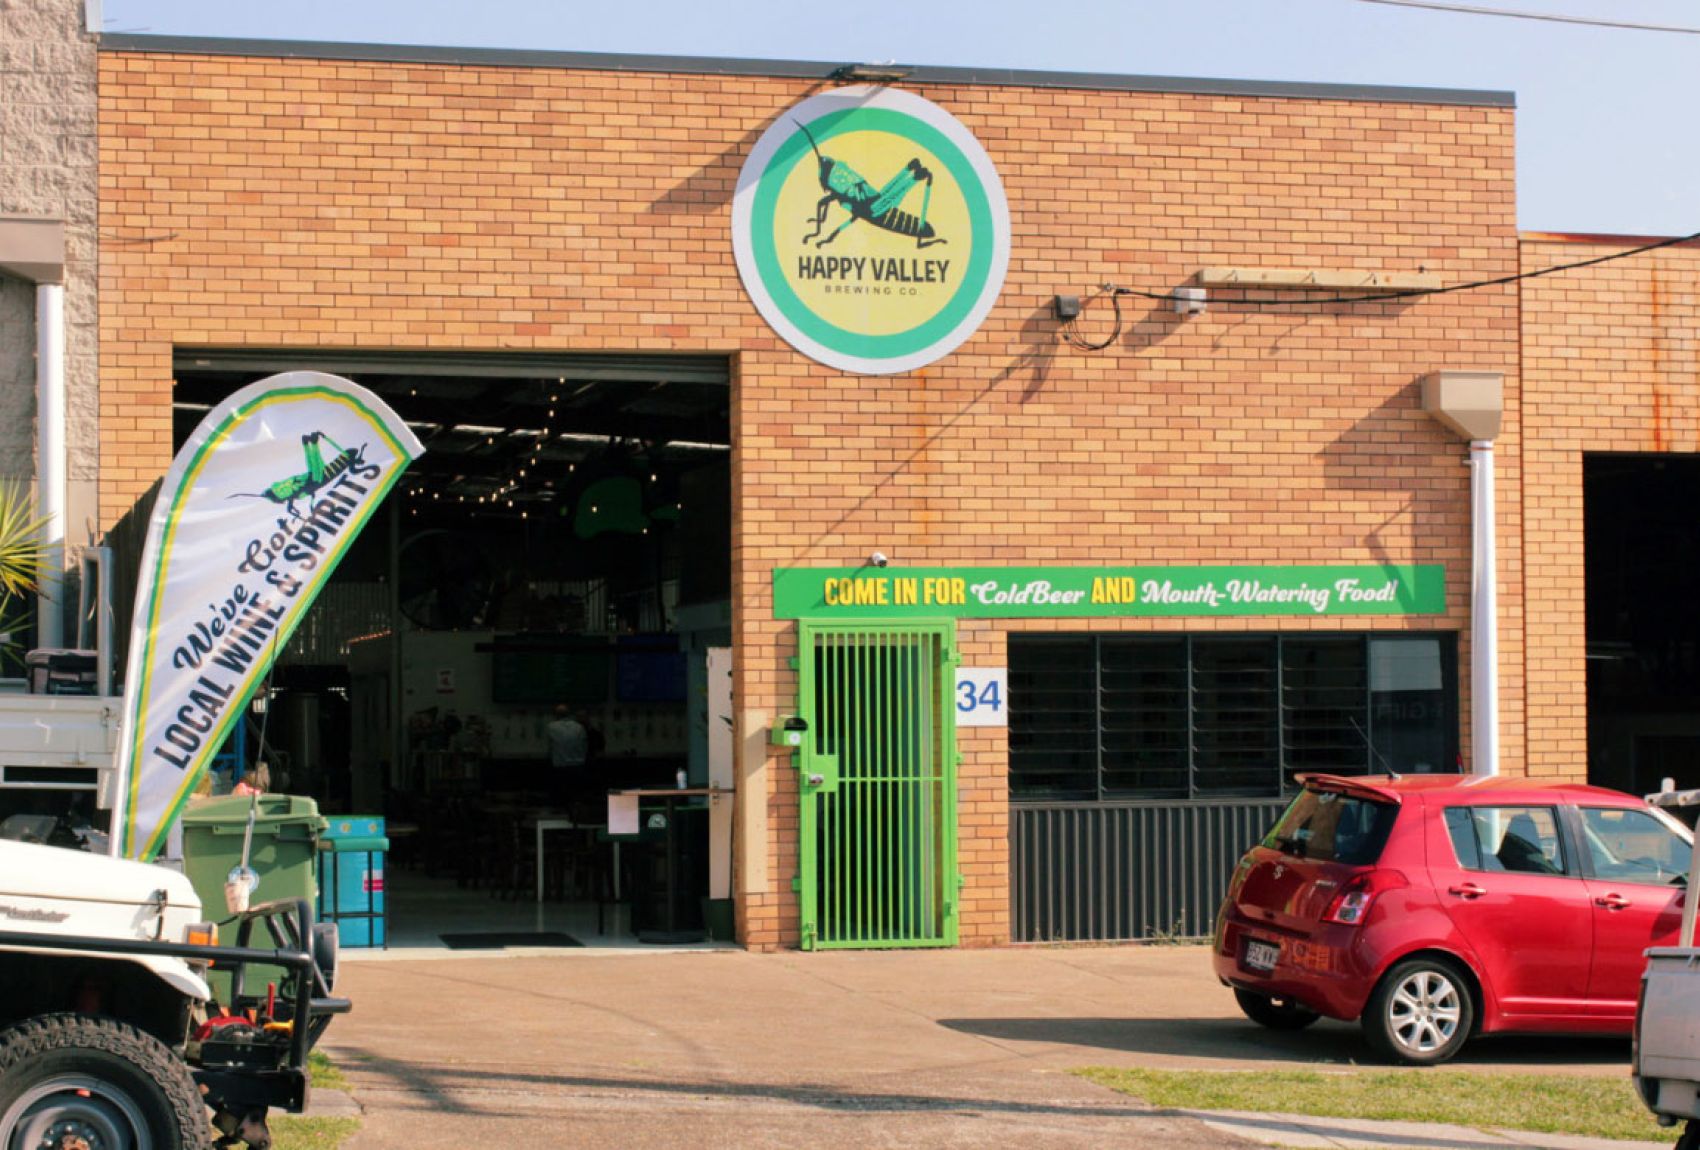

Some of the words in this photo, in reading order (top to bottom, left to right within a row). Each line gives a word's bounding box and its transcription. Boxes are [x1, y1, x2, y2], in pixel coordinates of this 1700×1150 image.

[798, 255, 866, 281] HAPPY
[871, 257, 950, 283] VALLEY
[824, 285, 892, 295] BREWING
[283, 460, 381, 571] SPIRITS
[265, 569, 303, 598] &
[824, 577, 889, 606] COME
[894, 577, 917, 605] IN
[923, 577, 965, 605] FOR
[1091, 577, 1136, 604] AND
[1142, 579, 1330, 613] Mouth-Watering
[1335, 578, 1399, 602] Food!
[173, 584, 248, 669] We've
[212, 592, 286, 675] WINE
[956, 680, 1001, 713] 34
[153, 676, 235, 770] LOCAL
